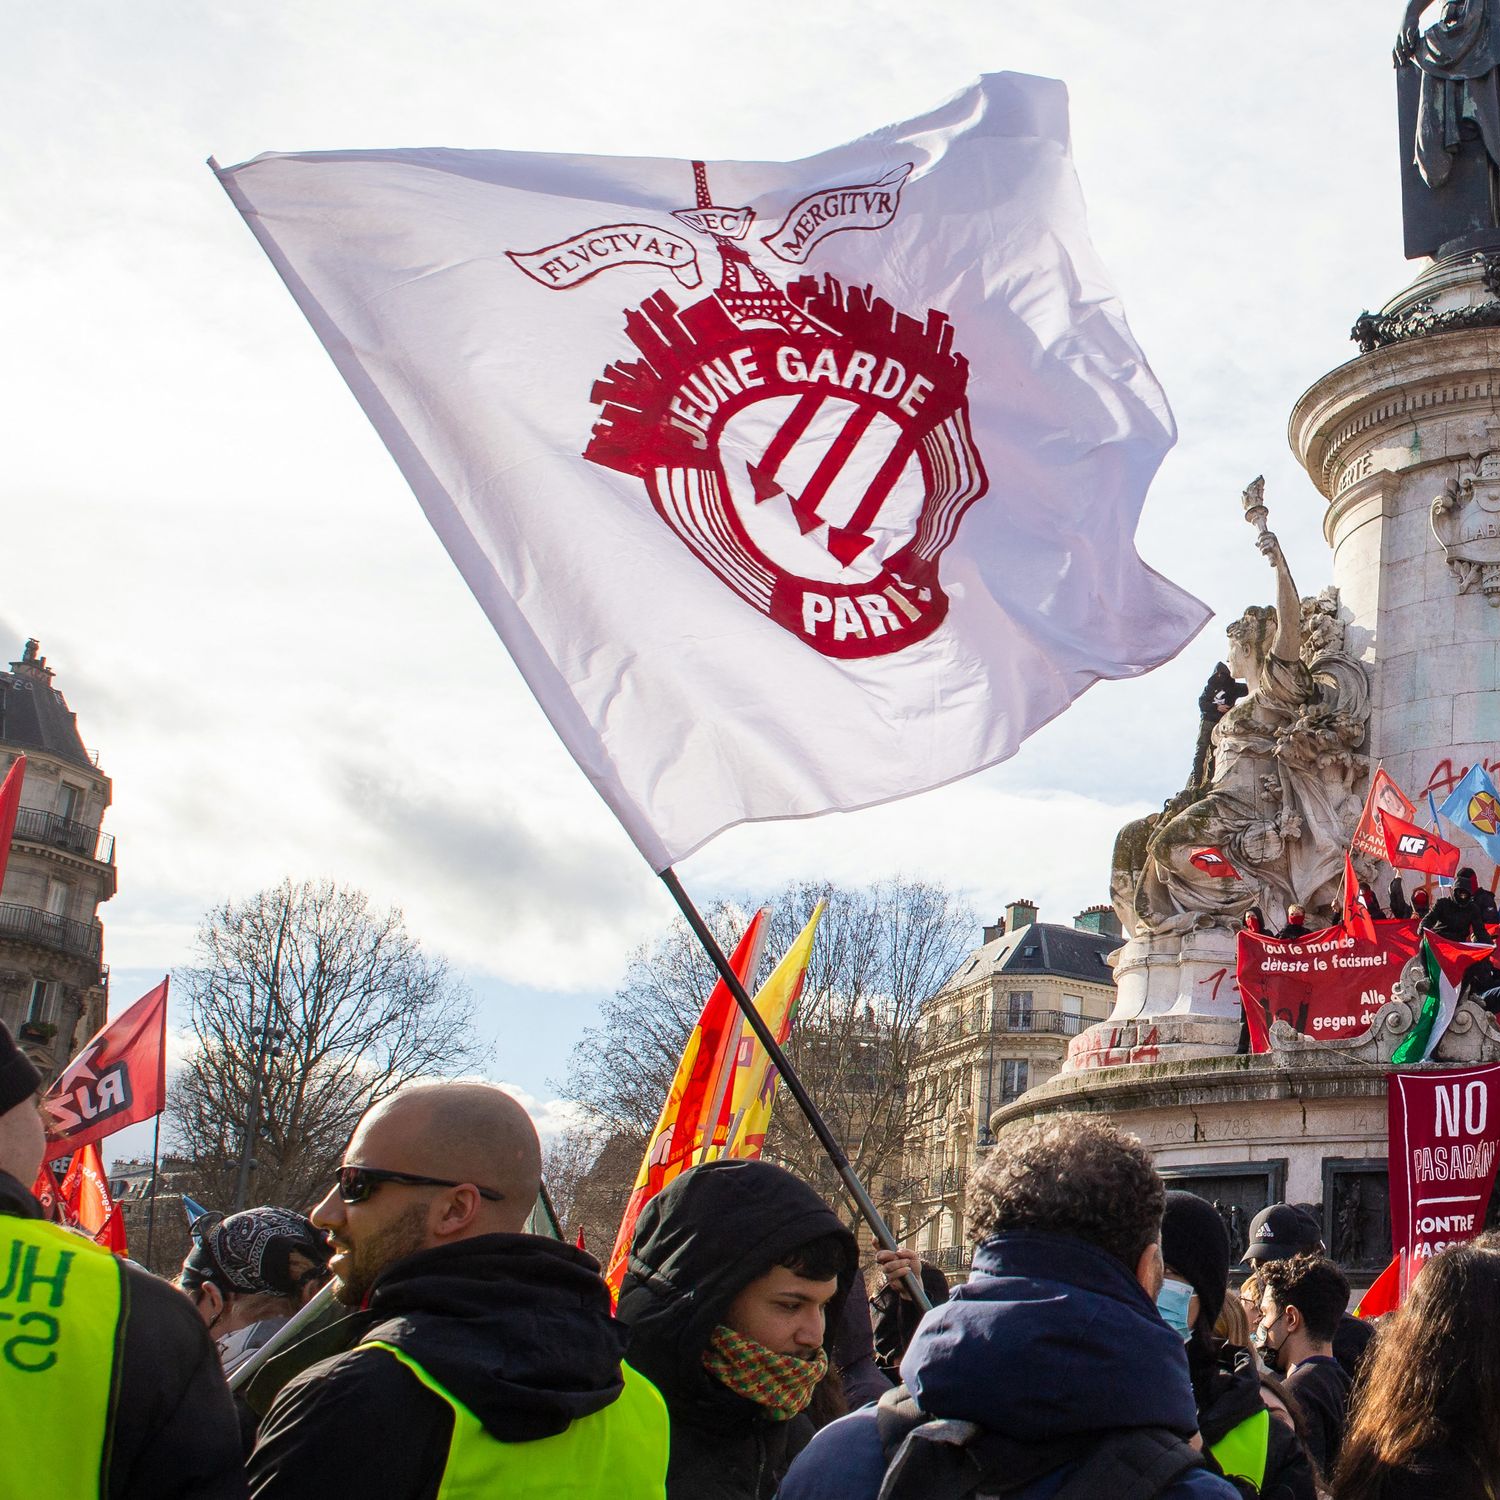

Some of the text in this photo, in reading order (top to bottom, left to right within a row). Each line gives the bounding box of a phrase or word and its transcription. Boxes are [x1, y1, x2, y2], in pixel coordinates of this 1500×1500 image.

[539, 191, 894, 283] FLVCTVAT NEC MERGITVR
[669, 346, 935, 450] JEUNE GARDE
[1399, 836, 1426, 854] KF
[1306, 937, 1356, 954] monde
[1261, 952, 1388, 973] déteste le facisme!
[1360, 988, 1386, 1005] Alle
[1313, 1013, 1356, 1031] gegen
[1434, 1080, 1488, 1138] NO
[1218, 1118, 1252, 1137] 1789
[1415, 1213, 1475, 1236] CONTRE
